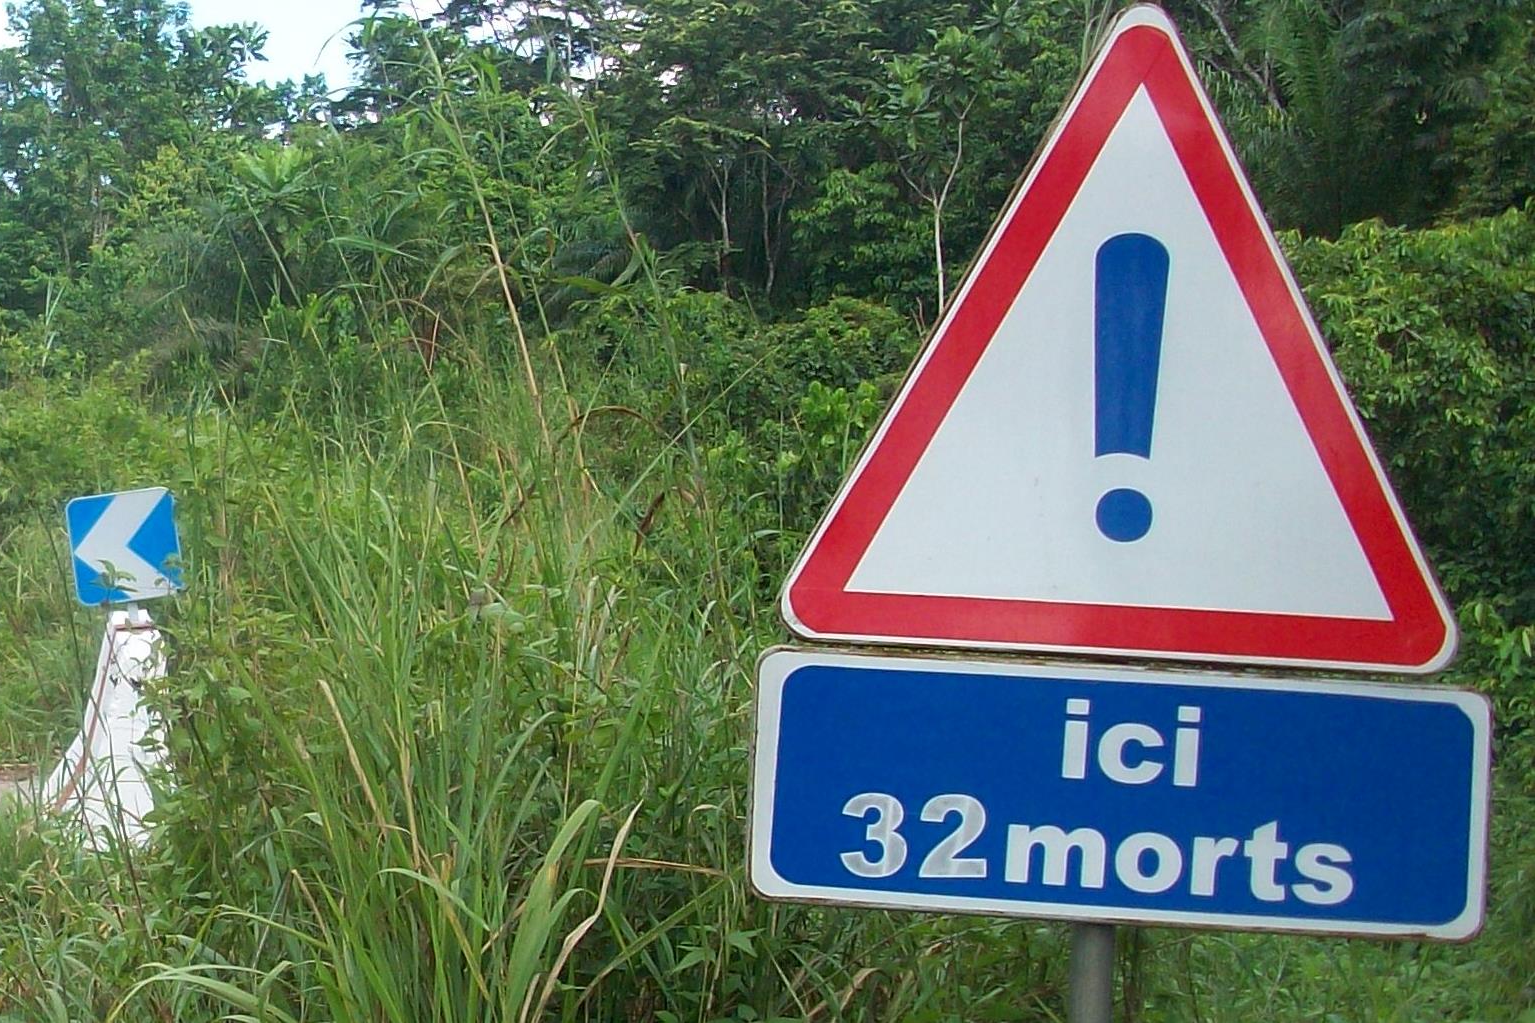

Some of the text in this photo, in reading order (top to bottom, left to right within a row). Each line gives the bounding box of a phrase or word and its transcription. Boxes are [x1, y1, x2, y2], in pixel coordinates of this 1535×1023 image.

[1061, 698, 1203, 787] ici
[840, 792, 1355, 906] 32 morts
